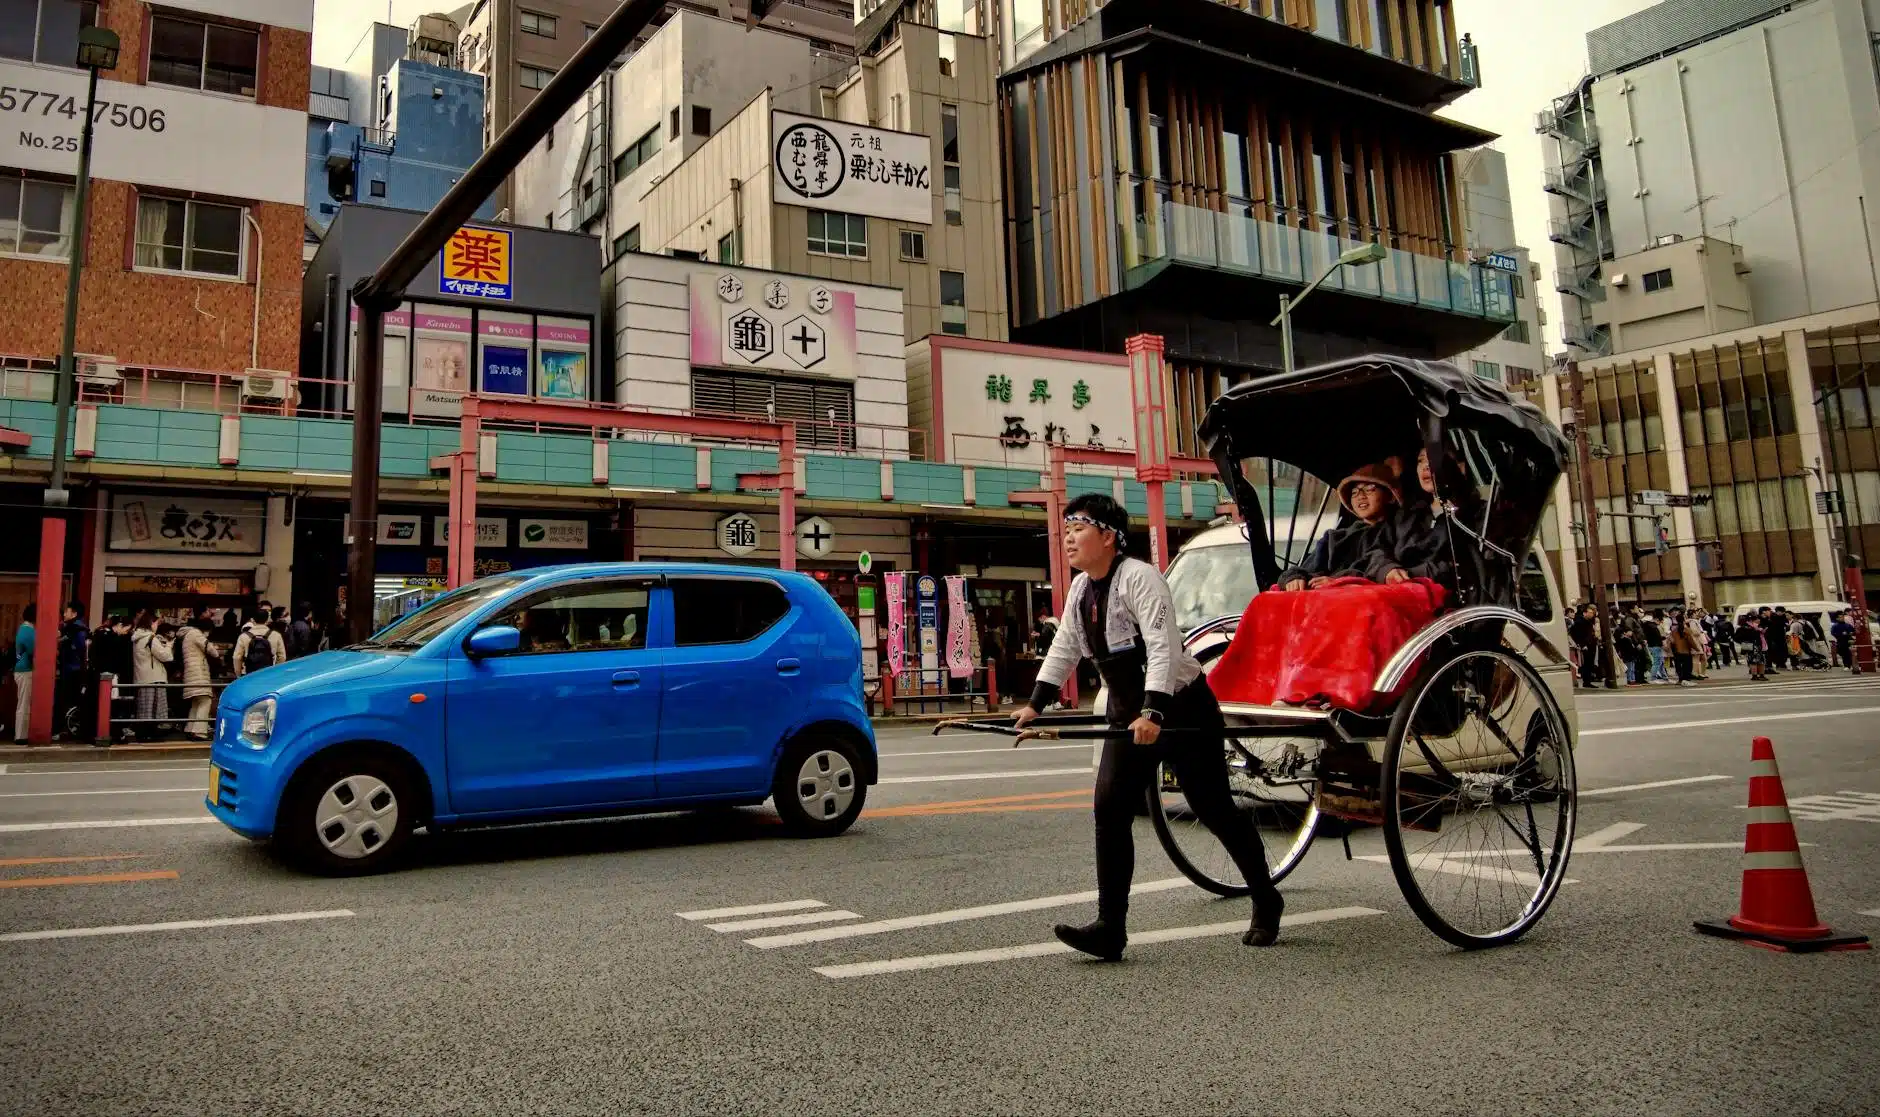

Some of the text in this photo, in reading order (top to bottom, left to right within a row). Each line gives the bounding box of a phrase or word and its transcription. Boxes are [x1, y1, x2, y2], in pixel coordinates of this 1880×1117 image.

[0, 86, 166, 133] 5774-7506
[850, 133, 882, 151] 元祖
[851, 154, 930, 189] 栗むし羊かん
[452, 230, 502, 281] 薬
[425, 394, 462, 404] Matsum
[477, 523, 499, 536] 付宝
